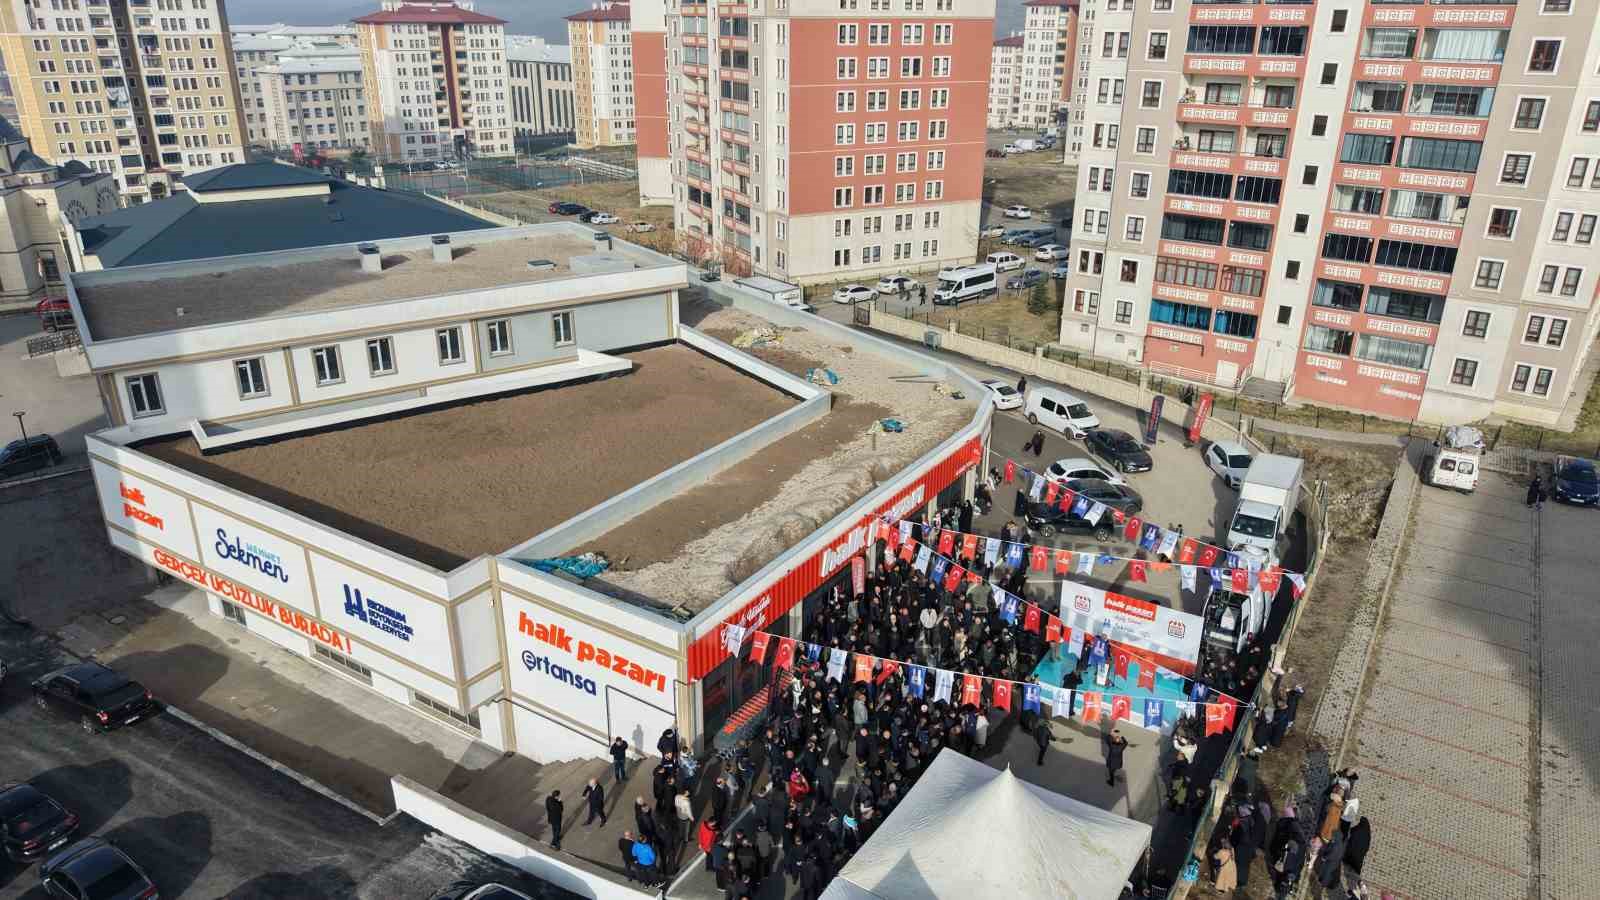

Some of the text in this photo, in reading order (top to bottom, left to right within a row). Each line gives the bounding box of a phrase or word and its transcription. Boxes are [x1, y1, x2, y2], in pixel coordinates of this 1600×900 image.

[215, 528, 288, 583] Sekmen
[153, 548, 208, 588] GERÇEK
[211, 574, 275, 617] UCUZLUK
[278, 607, 343, 650] BURADA
[519, 611, 666, 692] halk pazarı
[522, 650, 597, 696] ertansa
